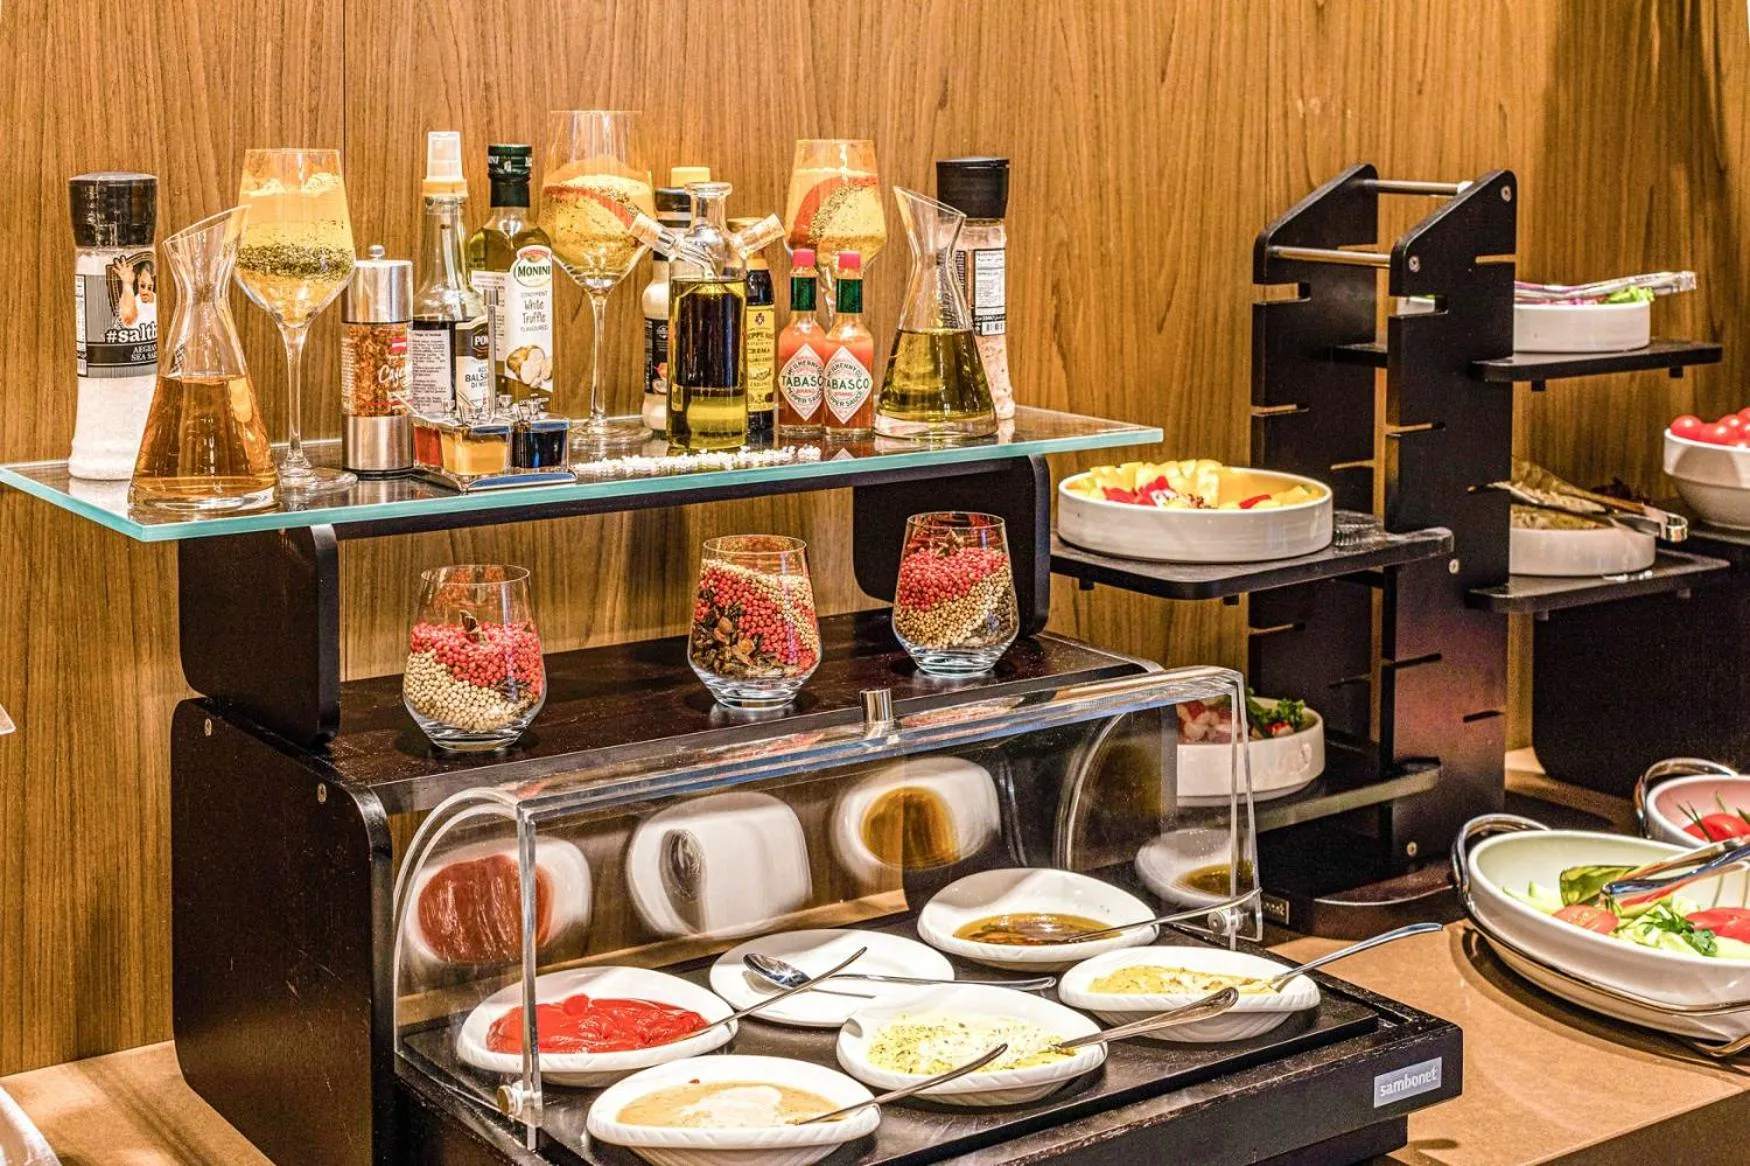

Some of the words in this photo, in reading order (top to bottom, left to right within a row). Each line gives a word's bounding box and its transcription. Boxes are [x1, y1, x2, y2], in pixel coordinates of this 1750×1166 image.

[517, 265, 551, 277] MONINI
[524, 299, 545, 310] White
[522, 311, 546, 324] Truffle
[1380, 1064, 1438, 1097] sambonet
